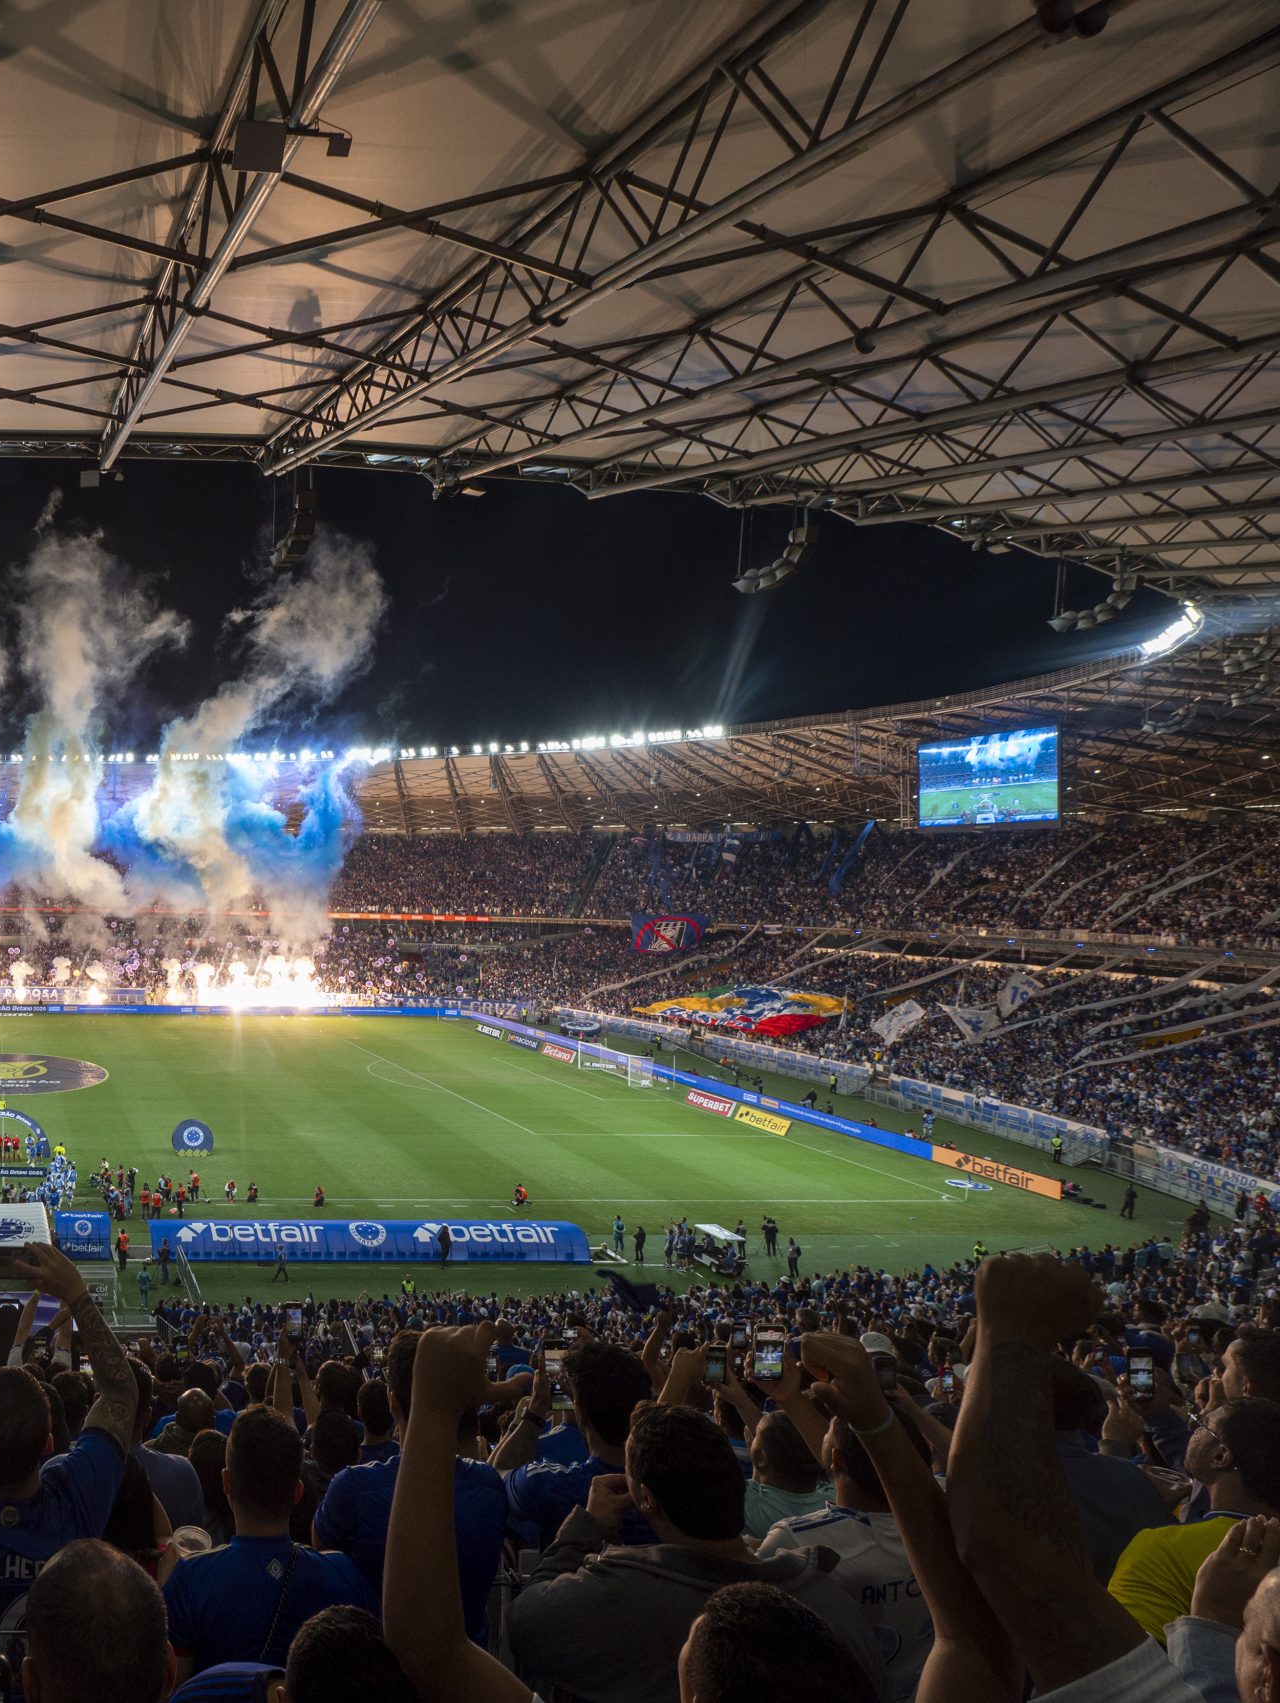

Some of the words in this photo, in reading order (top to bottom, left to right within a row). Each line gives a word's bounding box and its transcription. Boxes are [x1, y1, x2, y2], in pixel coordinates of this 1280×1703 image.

[4, 988, 59, 998] RPOSA
[506, 1033, 538, 1048] betnacional
[543, 1045, 571, 1060] Betano
[687, 1091, 731, 1112] SUPERBET
[748, 1113, 787, 1133] betfair
[972, 1157, 1034, 1189] betfair
[1192, 1160, 1258, 1189] COMANDO
[209, 1222, 324, 1243] betfair
[71, 1242, 105, 1253] betfair
